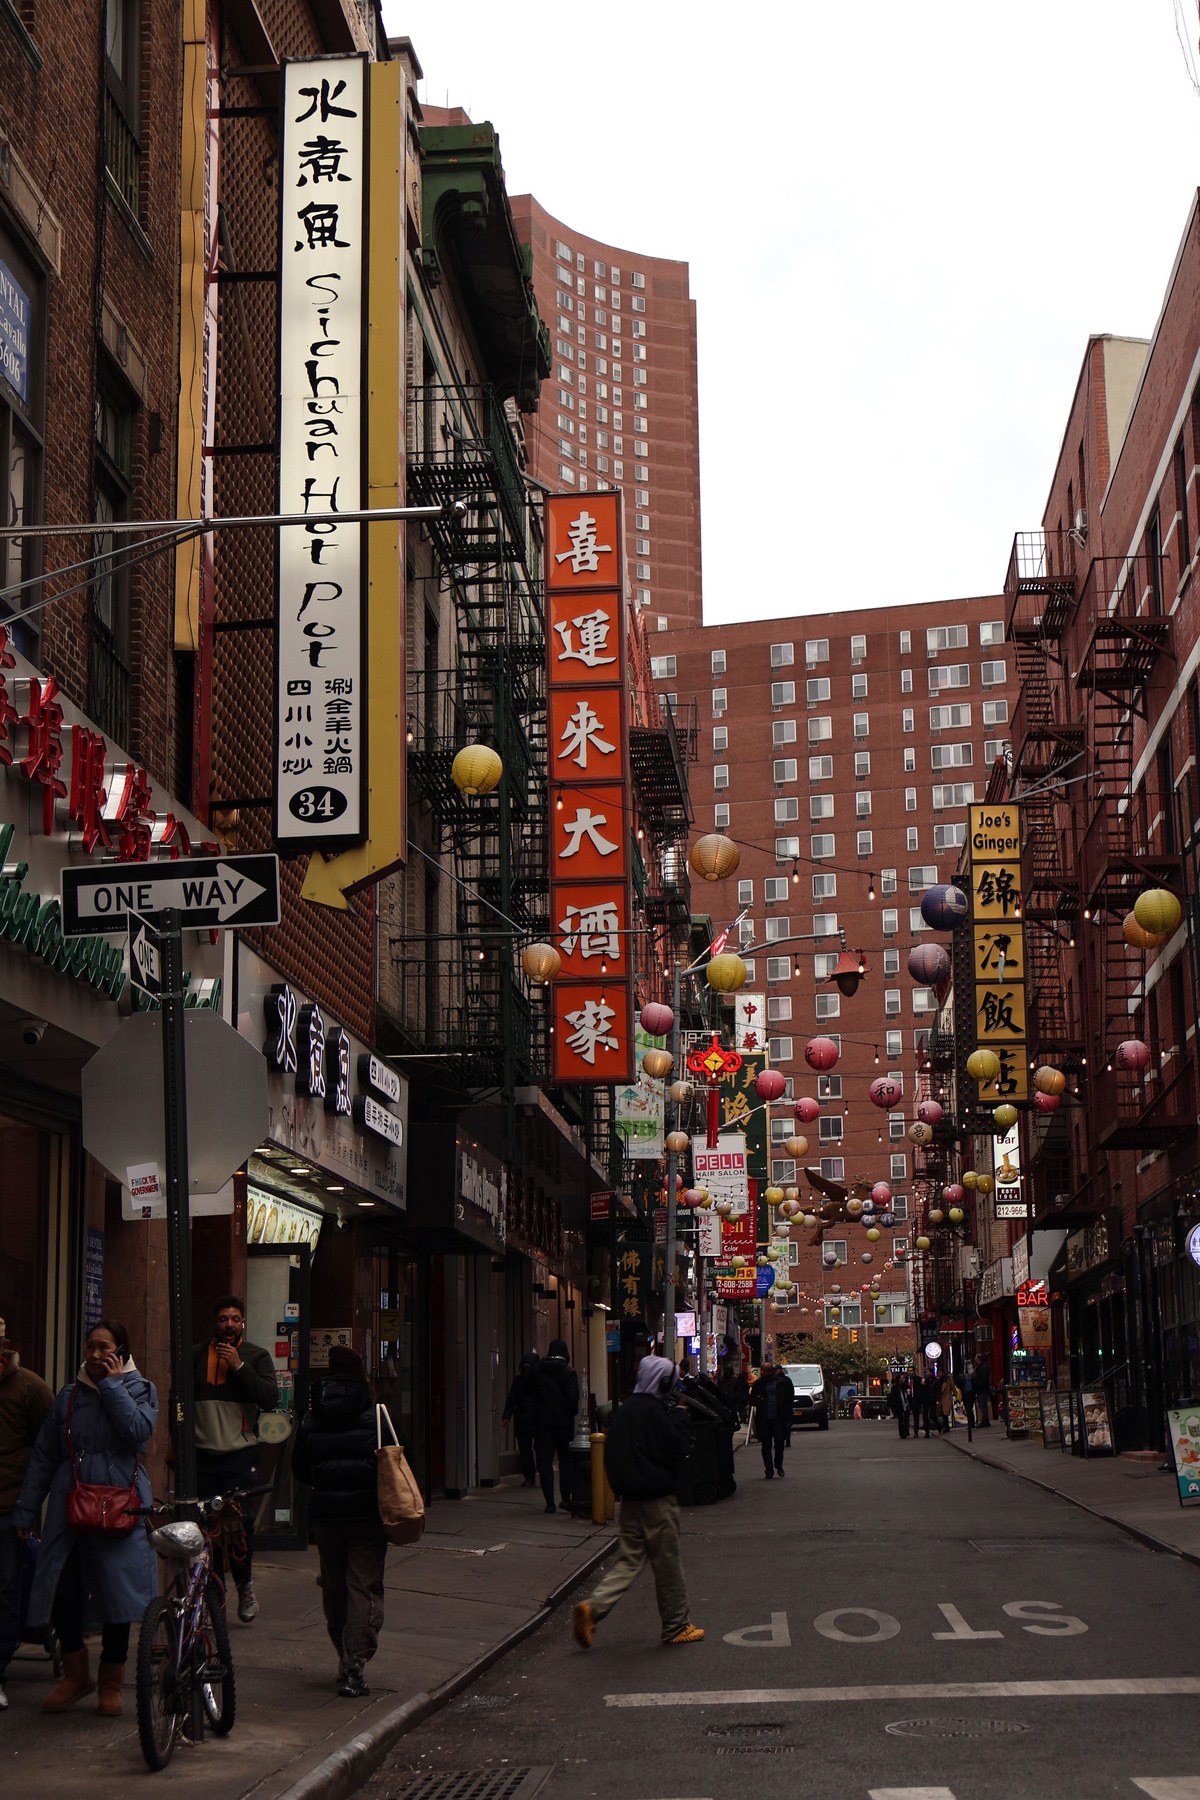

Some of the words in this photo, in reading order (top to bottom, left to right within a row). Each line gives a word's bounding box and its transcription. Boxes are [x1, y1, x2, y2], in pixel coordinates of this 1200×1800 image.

[295, 78, 357, 252] 水煮魚
[303, 272, 345, 462] Sichuan
[300, 476, 343, 566] Hot
[297, 581, 343, 668] Pot
[282, 679, 312, 775] 四川小炒
[323, 678, 353, 775] 涮全羊火鍋
[298, 790, 335, 817] 34
[554, 510, 619, 1065] 喜運來大酒家
[978, 811, 1012, 829] Joe's
[972, 833, 1019, 852] Ginger
[93, 884, 154, 913] ONE
[182, 878, 245, 907] WAY
[138, 940, 155, 975] ONE
[976, 867, 1024, 1094] 錦江飯店
[876, 1083, 896, 1103] 和
[696, 1154, 743, 1170] PELL
[696, 1170, 715, 1178] HAIR
[718, 1169, 745, 1177] SALON
[132, 1183, 158, 1196] GOVERNMENT
[710, 1268, 729, 1276] Doyers
[1017, 1291, 1049, 1306] BAR
[722, 1600, 1090, 1648] STOP
